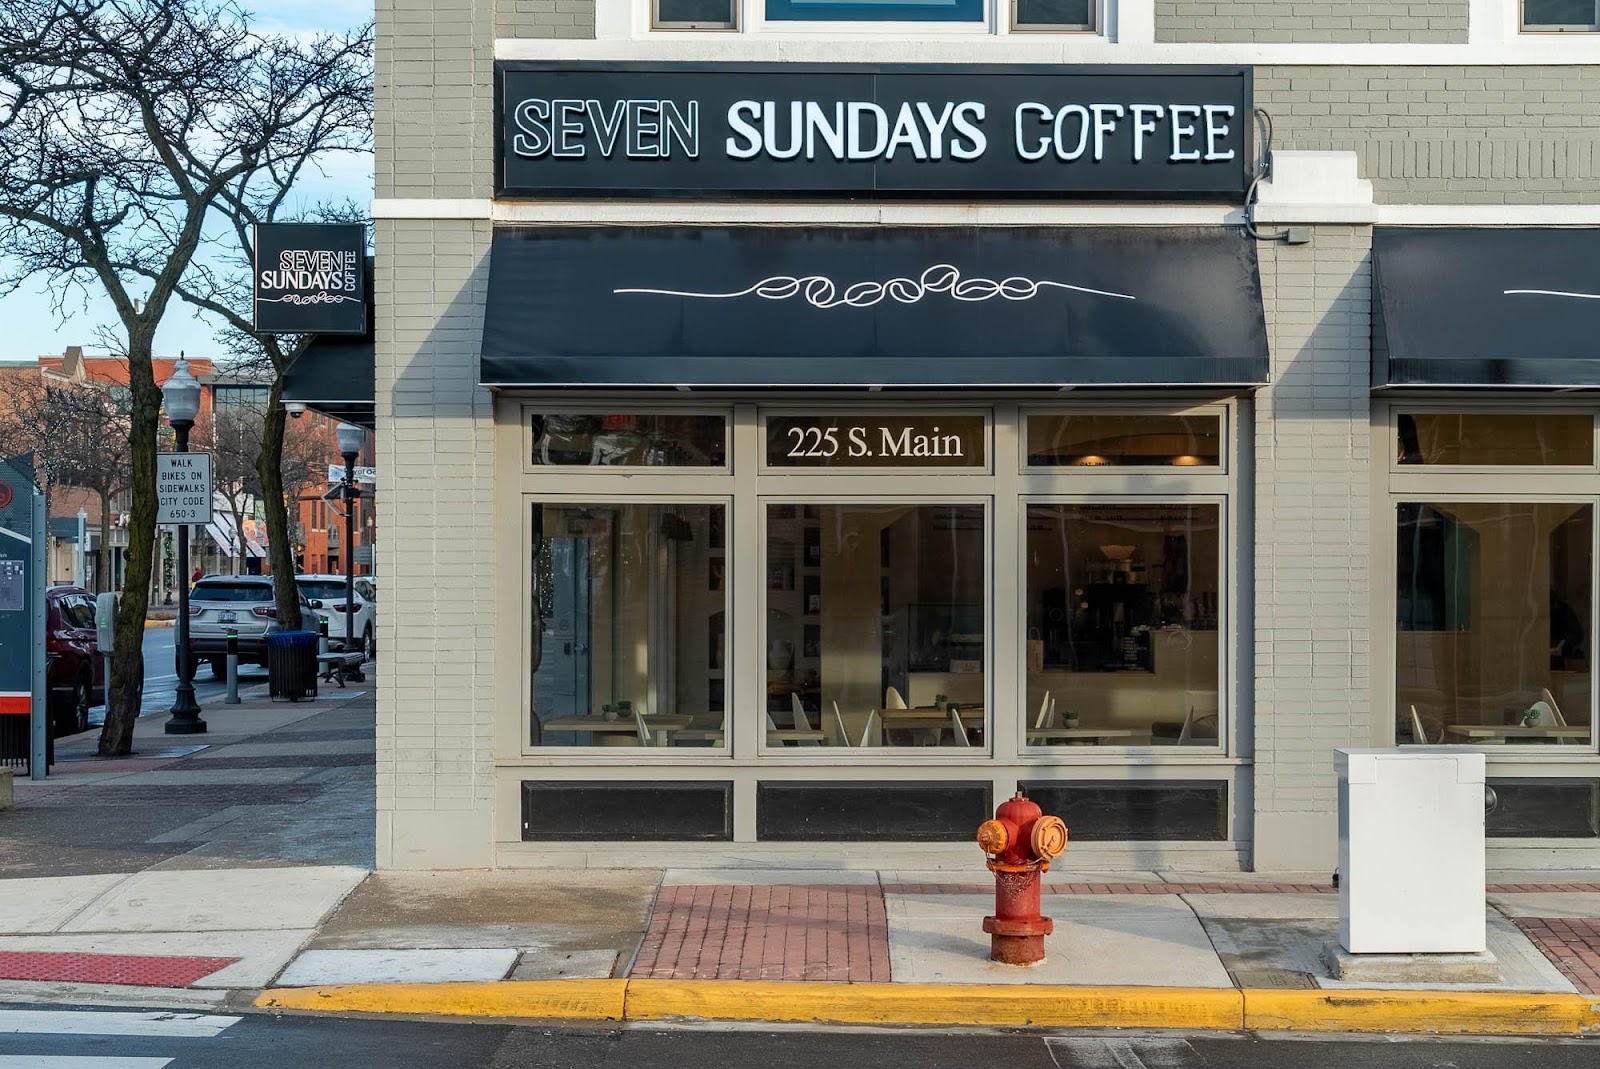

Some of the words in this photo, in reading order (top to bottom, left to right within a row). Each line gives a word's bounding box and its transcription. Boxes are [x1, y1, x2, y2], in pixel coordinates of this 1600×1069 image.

[514, 98, 699, 157] SEVEN
[725, 100, 987, 160] SUNDAYS
[1015, 102, 1235, 161] COFFEE
[280, 250, 343, 271] SEVEN
[344, 251, 356, 292] COFFEE
[261, 271, 343, 289] SUNDAYS
[787, 427, 839, 457] 225
[848, 427, 873, 457] S.
[878, 426, 964, 457] Main
[170, 459, 193, 467] WALK
[162, 471, 186, 481] BIKES
[191, 471, 202, 480] ON
[159, 484, 206, 493] SIDEWALKS
[161, 497, 178, 506] CITY
[183, 497, 205, 506] CODE
[170, 509, 196, 518] 650-3
